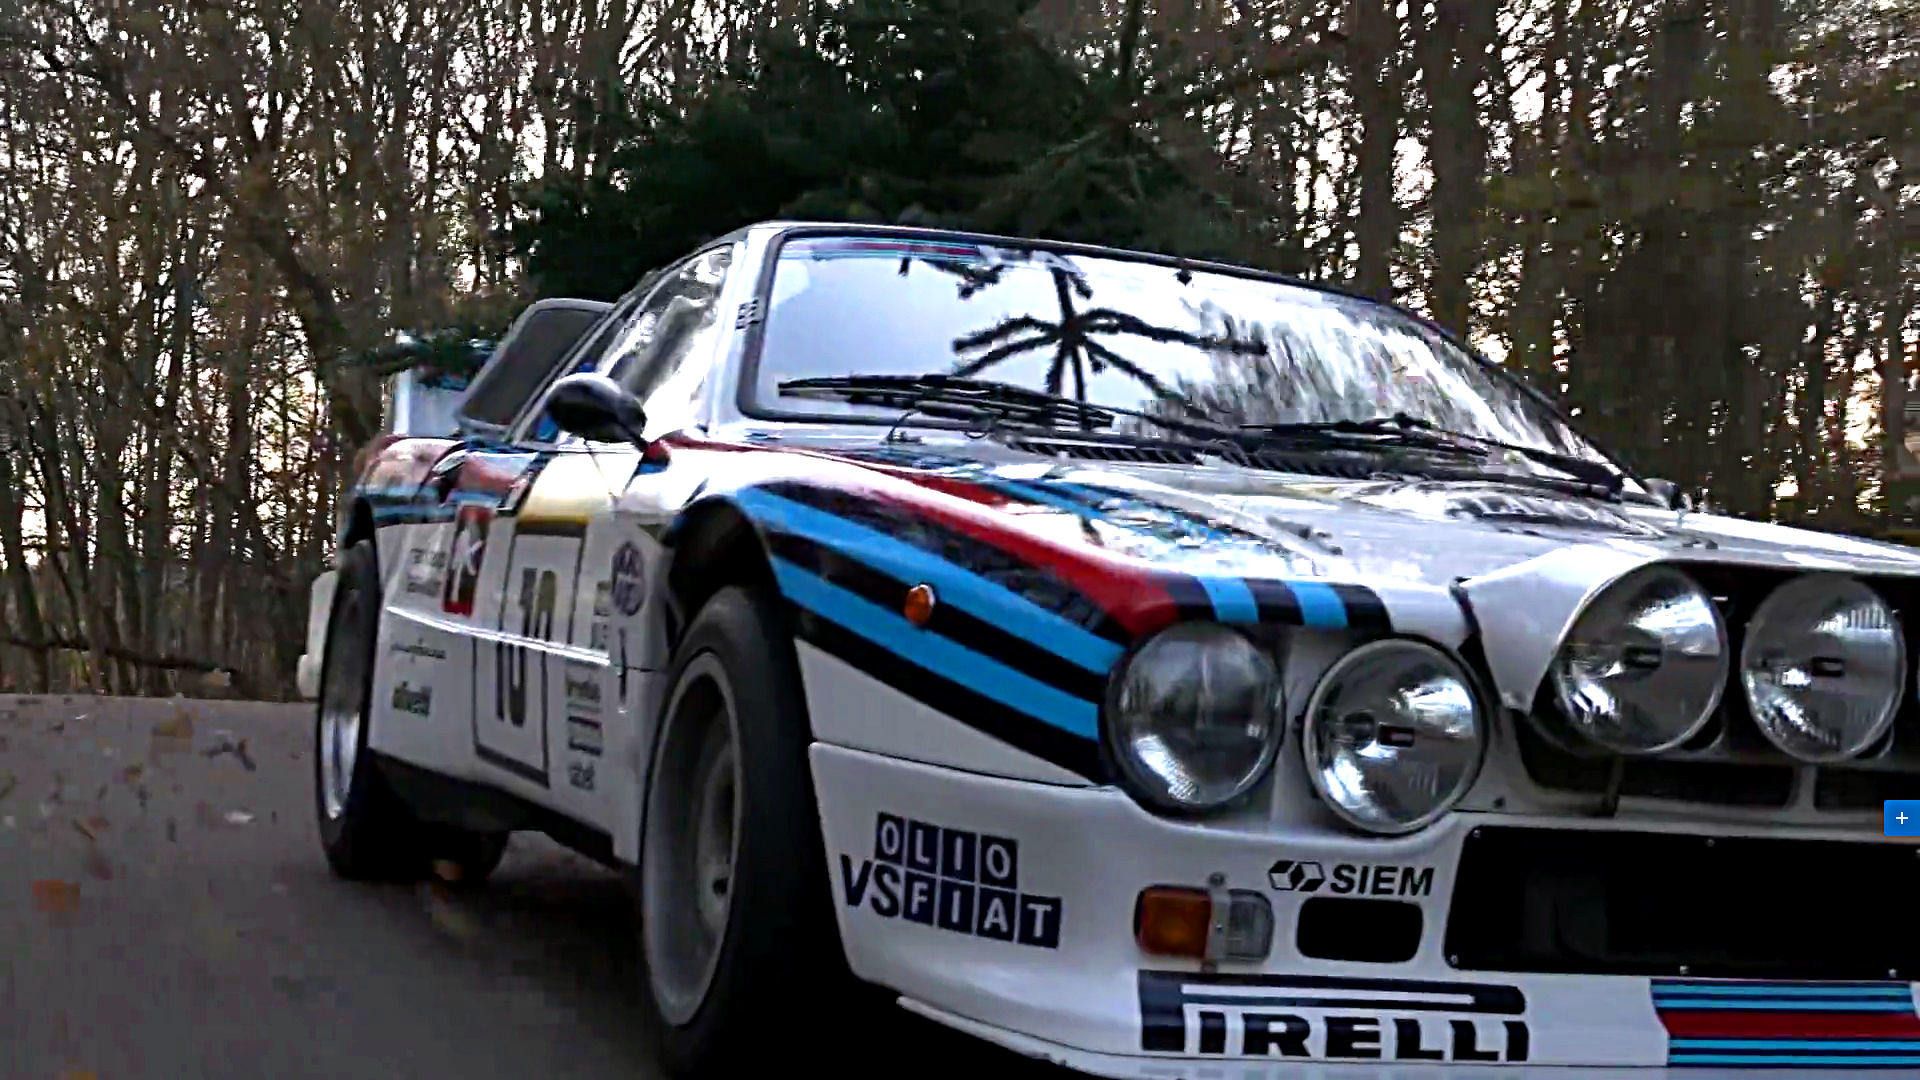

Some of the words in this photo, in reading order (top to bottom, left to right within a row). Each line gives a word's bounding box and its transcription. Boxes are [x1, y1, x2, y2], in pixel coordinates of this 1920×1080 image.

[877, 816, 1015, 885] OLIO
[1330, 863, 1434, 897] SIEM
[906, 875, 1058, 944] FIAT
[1138, 969, 1530, 1062] PIRELLI
